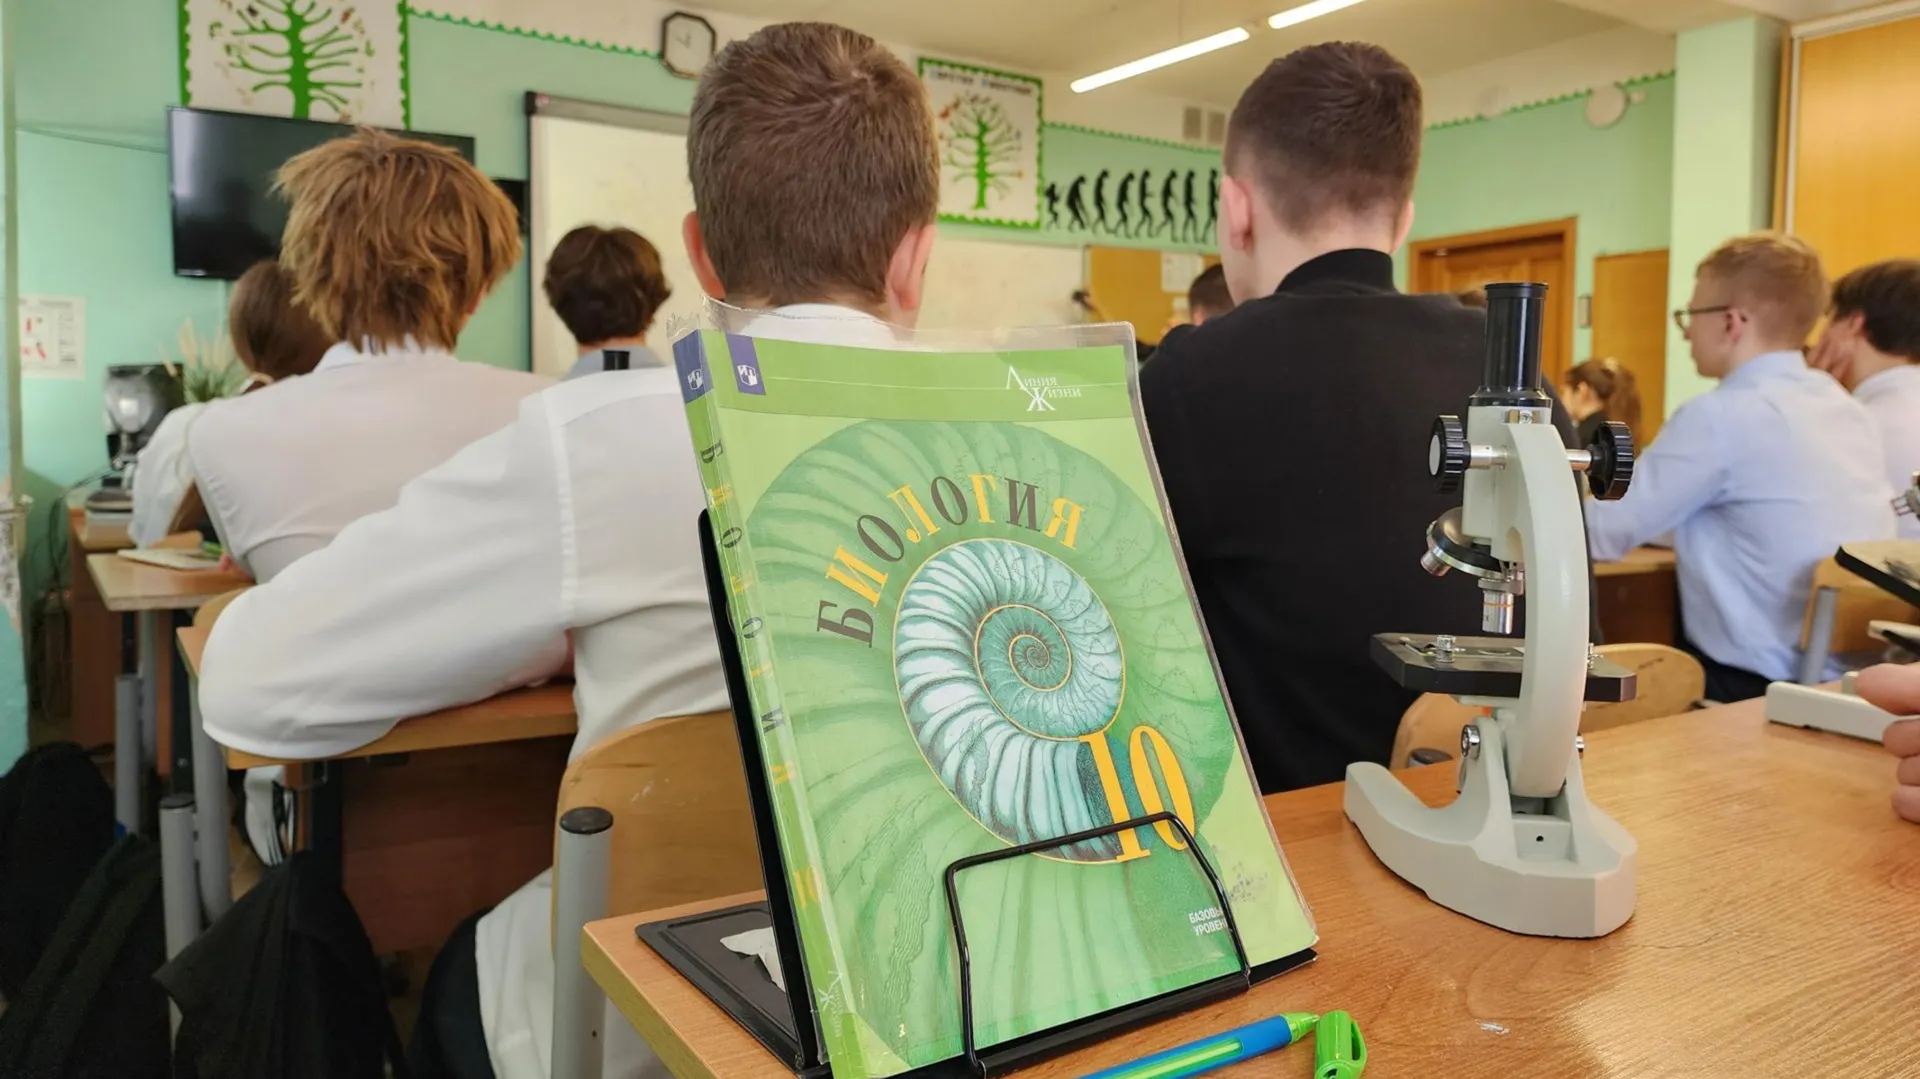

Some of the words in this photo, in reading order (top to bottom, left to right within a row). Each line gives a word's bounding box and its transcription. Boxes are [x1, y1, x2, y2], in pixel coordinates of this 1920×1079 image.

[817, 474, 1084, 648] БИОЛОГИЯ
[1079, 725, 1196, 862] 10
[1188, 905, 1225, 924] БАЗОВЫ
[1193, 917, 1229, 936] УРОВЕН
